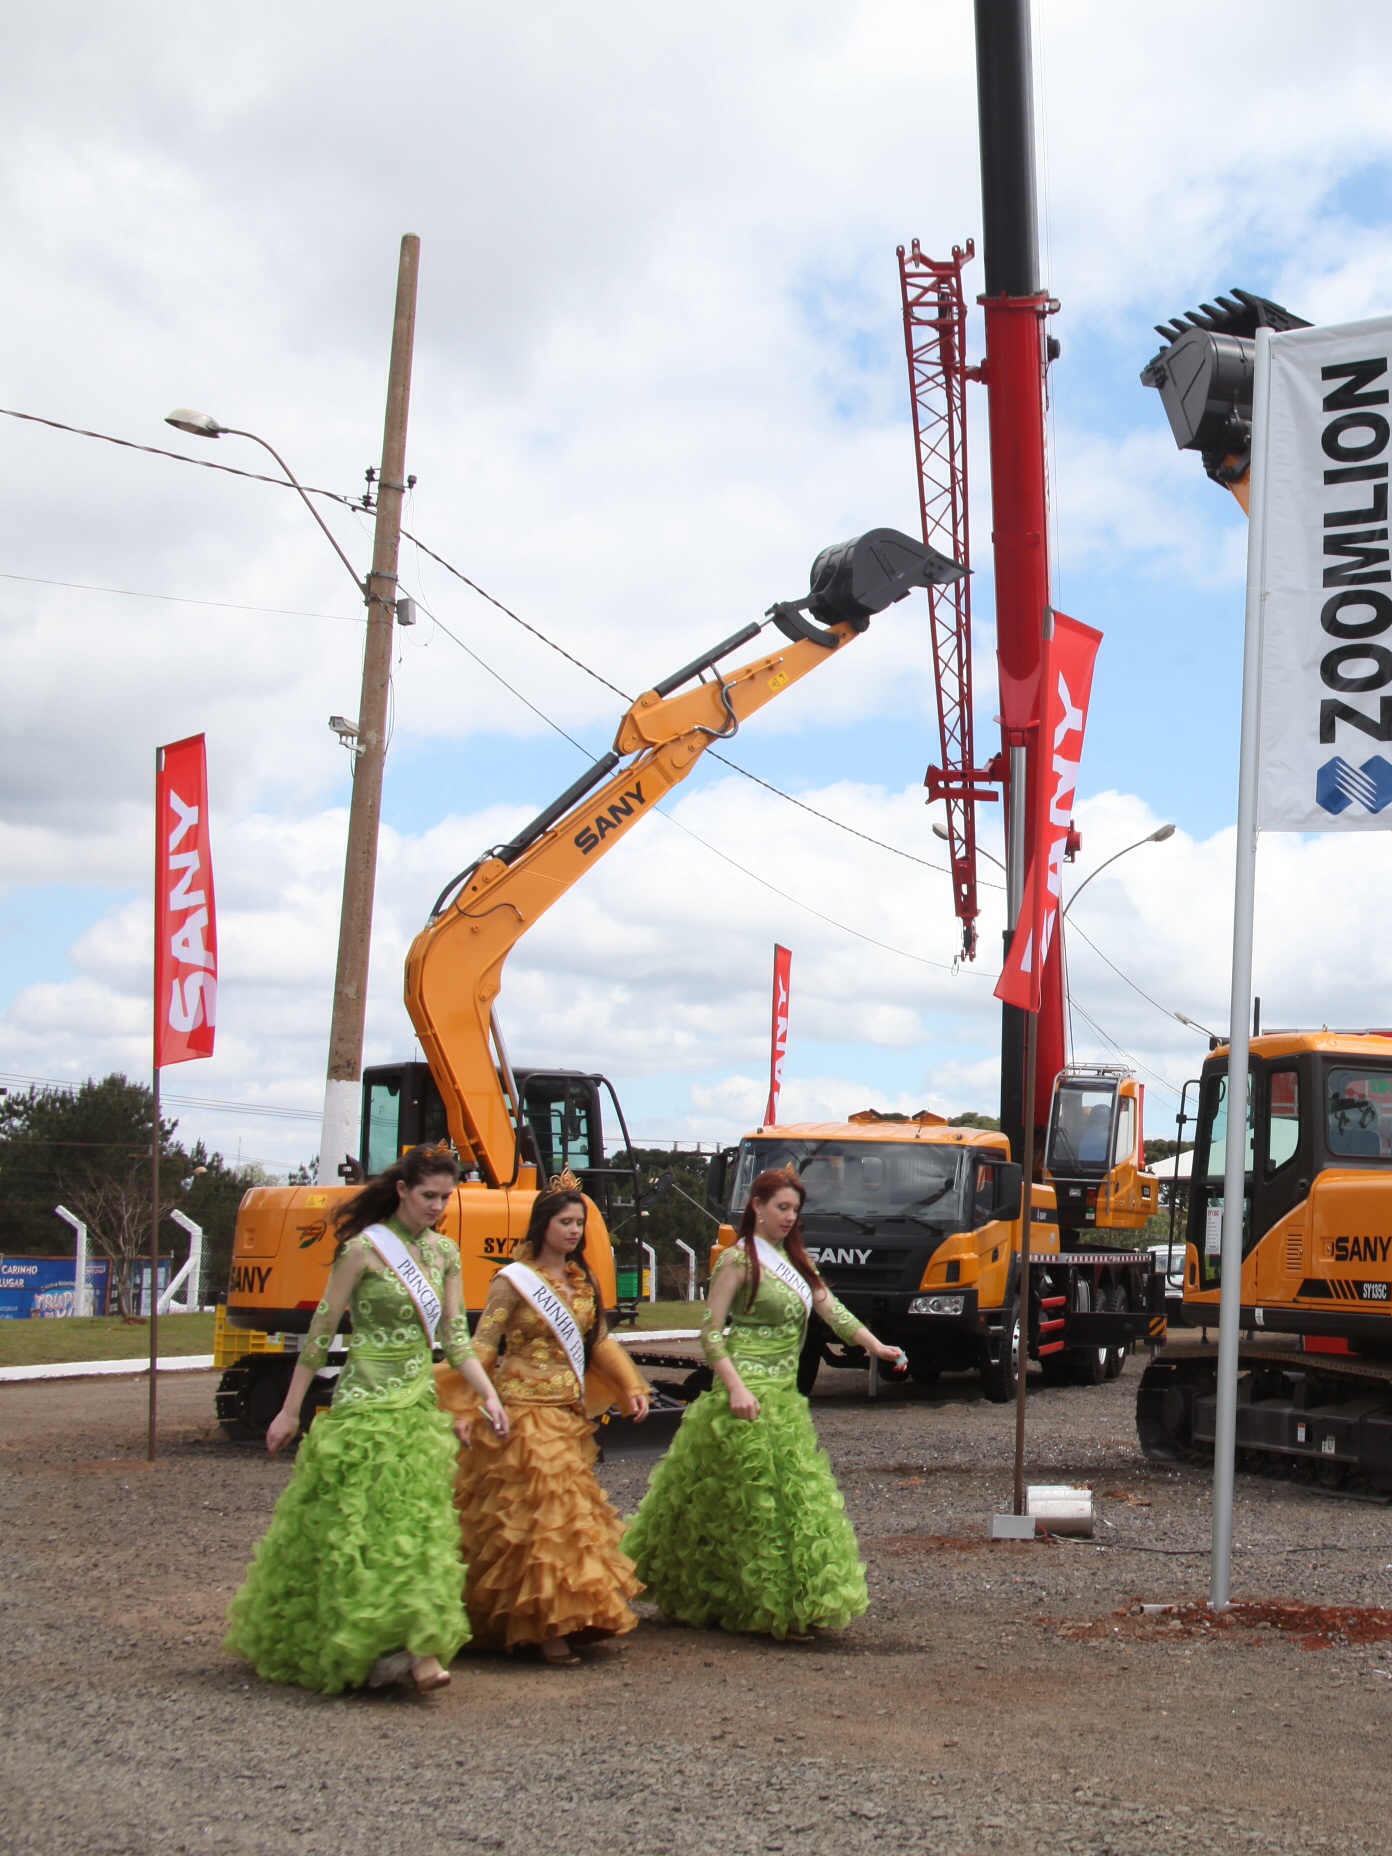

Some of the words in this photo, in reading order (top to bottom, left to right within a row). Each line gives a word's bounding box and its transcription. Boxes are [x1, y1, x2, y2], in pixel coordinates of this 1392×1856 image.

[574, 781, 647, 855] SANY
[168, 788, 217, 1033] SANY
[805, 1247, 873, 1265] SANY
[1335, 1236, 1392, 1262] SANY
[1, 1265, 38, 1275] CARINHO
[397, 1259, 442, 1324] PRINCESA
[1363, 1283, 1387, 1300] SY135C
[533, 1286, 576, 1341] RAINHA
